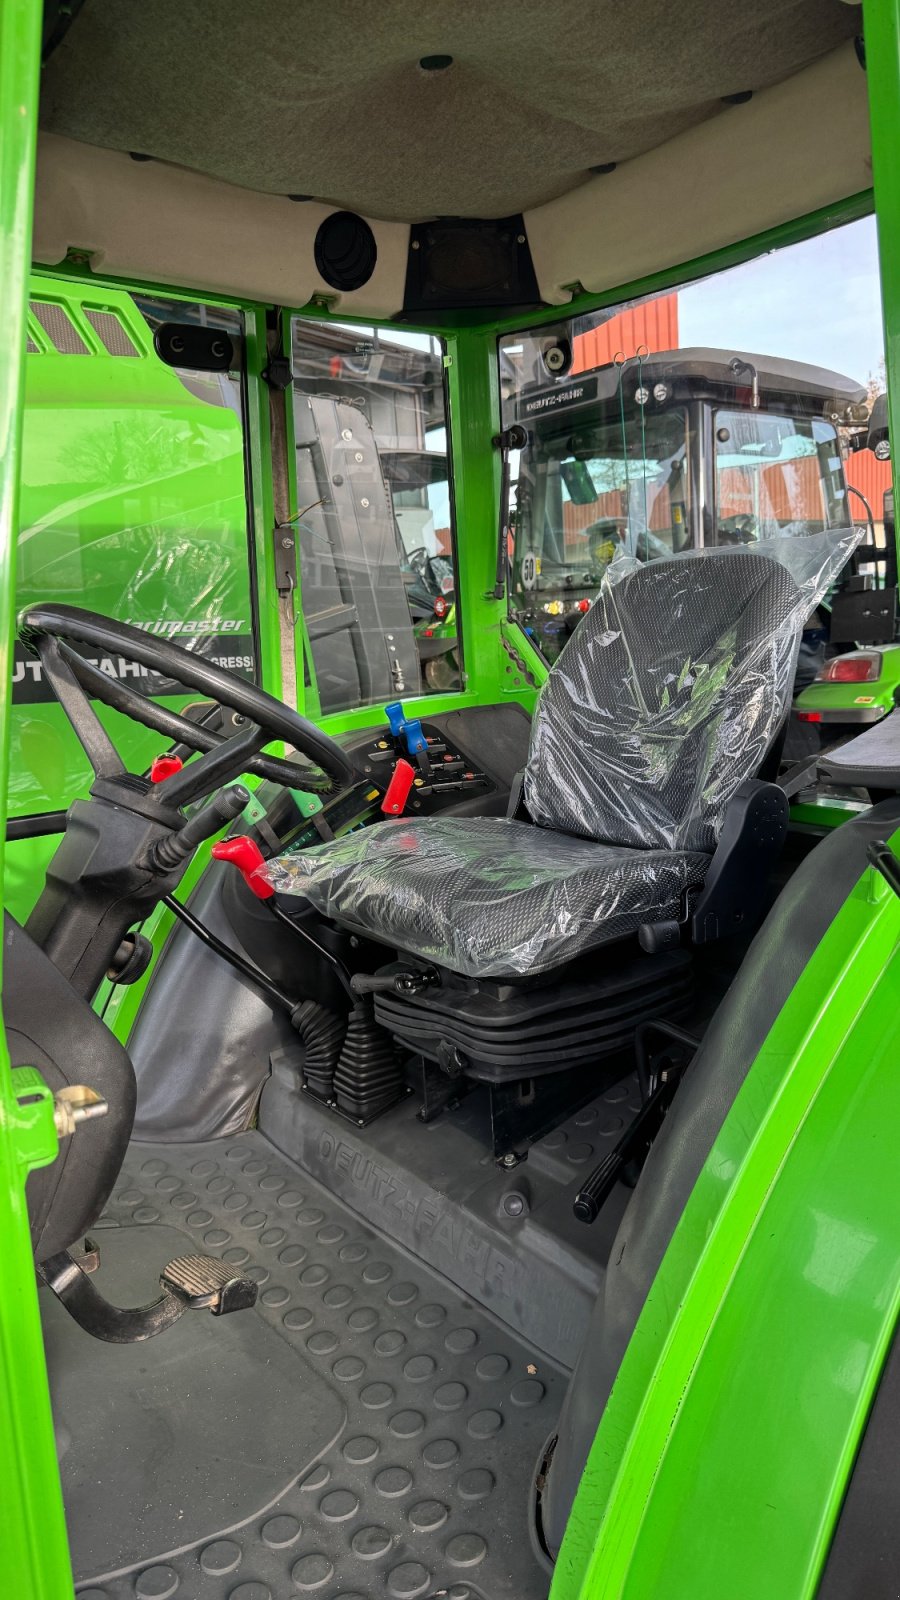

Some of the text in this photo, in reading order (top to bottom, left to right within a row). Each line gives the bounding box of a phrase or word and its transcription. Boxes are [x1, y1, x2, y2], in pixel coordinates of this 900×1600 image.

[526, 388, 584, 412] DEUTZ-FAHR
[524, 558, 534, 581] 50
[124, 617, 246, 634] arimaster
[319, 1130, 516, 1297] DEUTZ-FAHR
